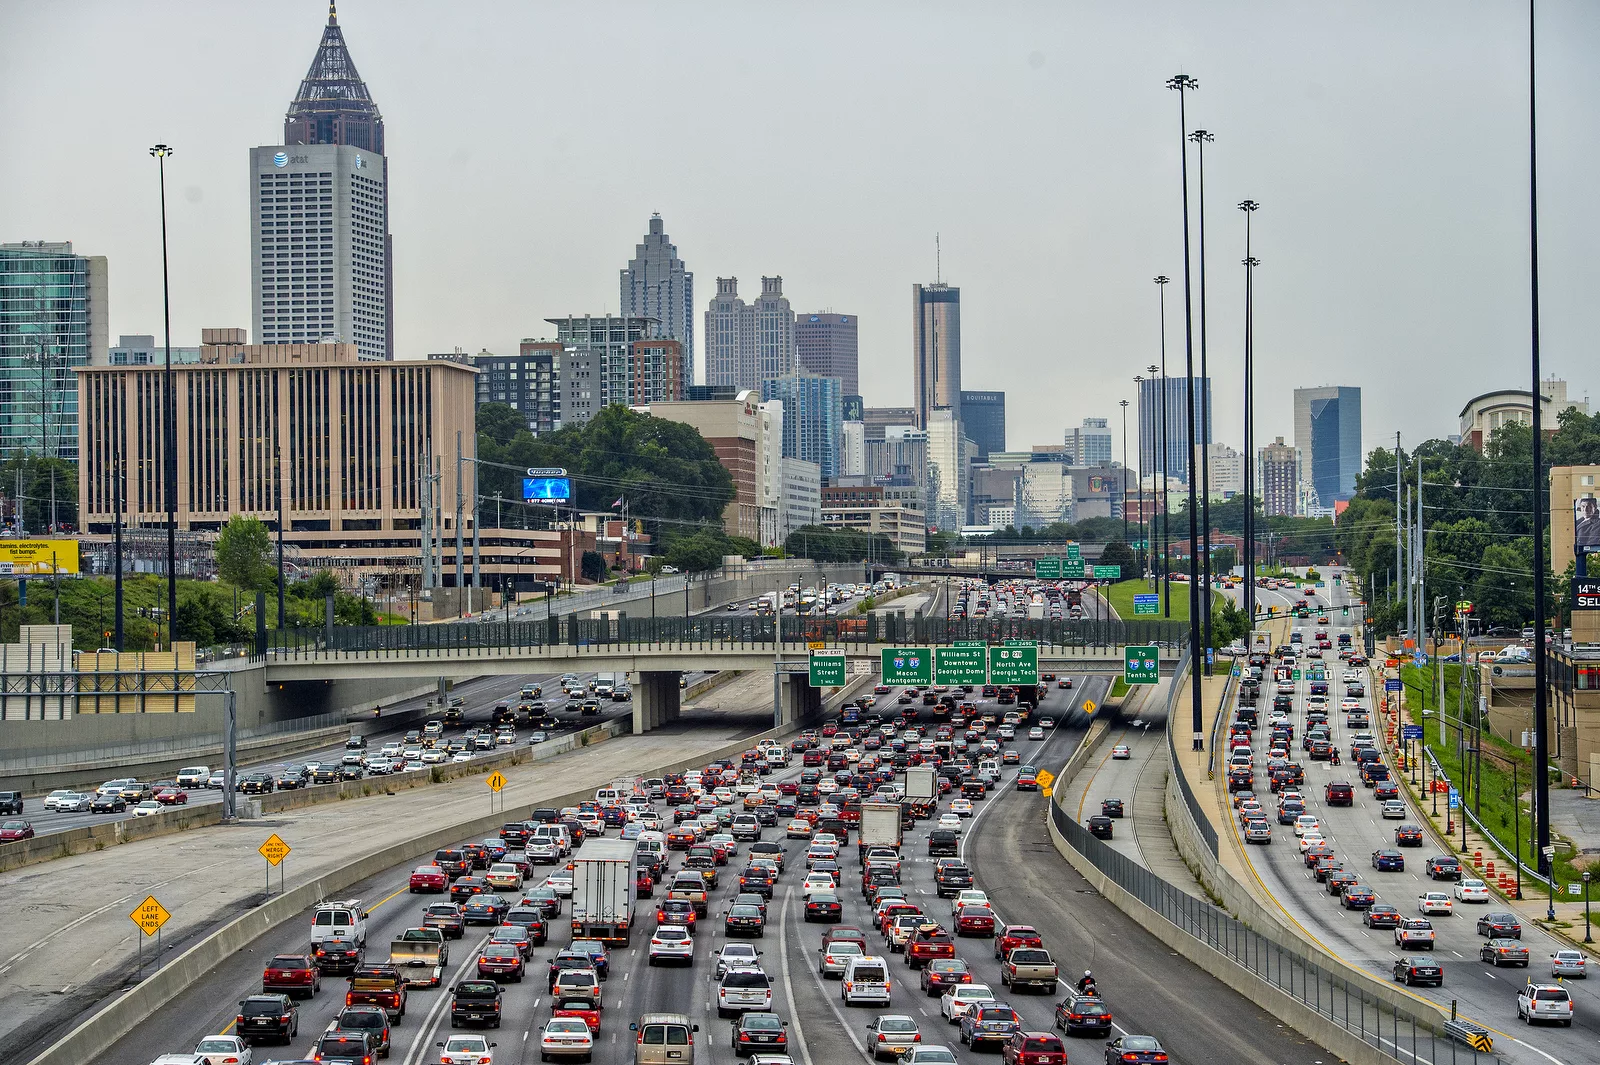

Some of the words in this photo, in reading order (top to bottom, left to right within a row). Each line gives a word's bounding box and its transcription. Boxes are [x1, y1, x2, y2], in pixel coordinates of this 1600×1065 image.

[991, 669, 1018, 677] Georgia
[1450, 794, 1458, 803] H
[141, 920, 159, 928] ENDS
